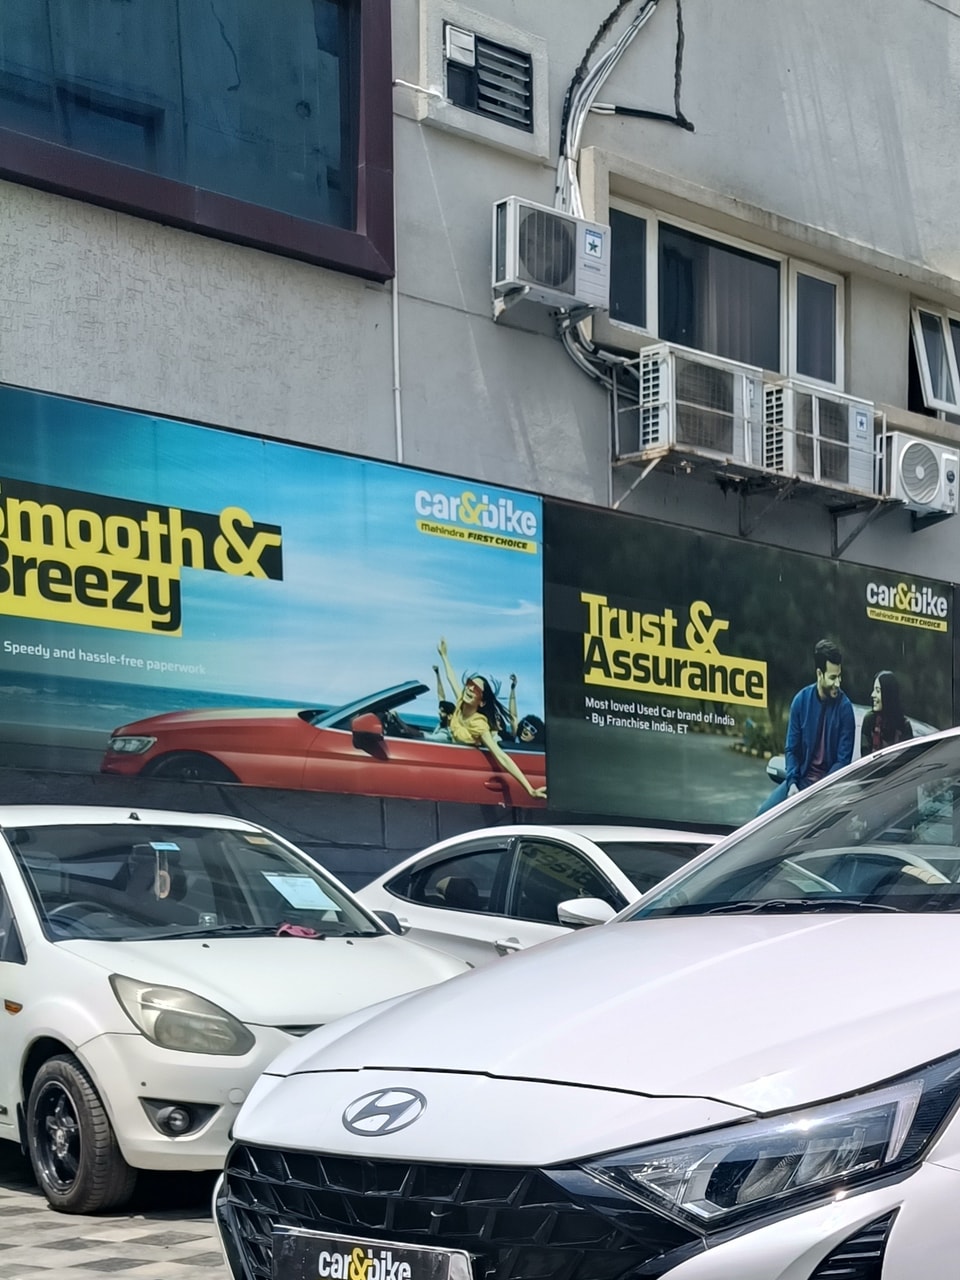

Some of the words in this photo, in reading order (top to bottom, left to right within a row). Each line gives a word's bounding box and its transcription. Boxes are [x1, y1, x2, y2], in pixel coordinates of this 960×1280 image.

[414, 490, 537, 536] car&bike
[0, 483, 204, 569] mooth
[213, 506, 282, 580] &
[420, 523, 465, 539] Mahindra
[467, 532, 495, 544] FIRST
[495, 537, 528, 549] CHOICE
[866, 582, 948, 618] car&bike
[580, 591, 678, 648] Trust
[685, 600, 730, 656] &
[900, 616, 919, 625] FIRST
[919, 619, 941, 629] CHOICE
[3, 641, 51, 659] Speedy
[53, 648, 76, 660] and
[78, 649, 144, 668] hassle-free
[146, 658, 207, 674] paperwork
[585, 636, 764, 700] Assurance
[585, 696, 609, 710] Most
[611, 700, 635, 713] loved
[637, 703, 660, 717] Used
[661, 706, 676, 718] Car
[677, 708, 702, 722] brand
[703, 713, 714, 723] of
[714, 714, 735, 726] India
[591, 713, 605, 727] By
[606, 714, 650, 730] Franchise
[651, 722, 676, 735] India,
[677, 723, 689, 735] ET
